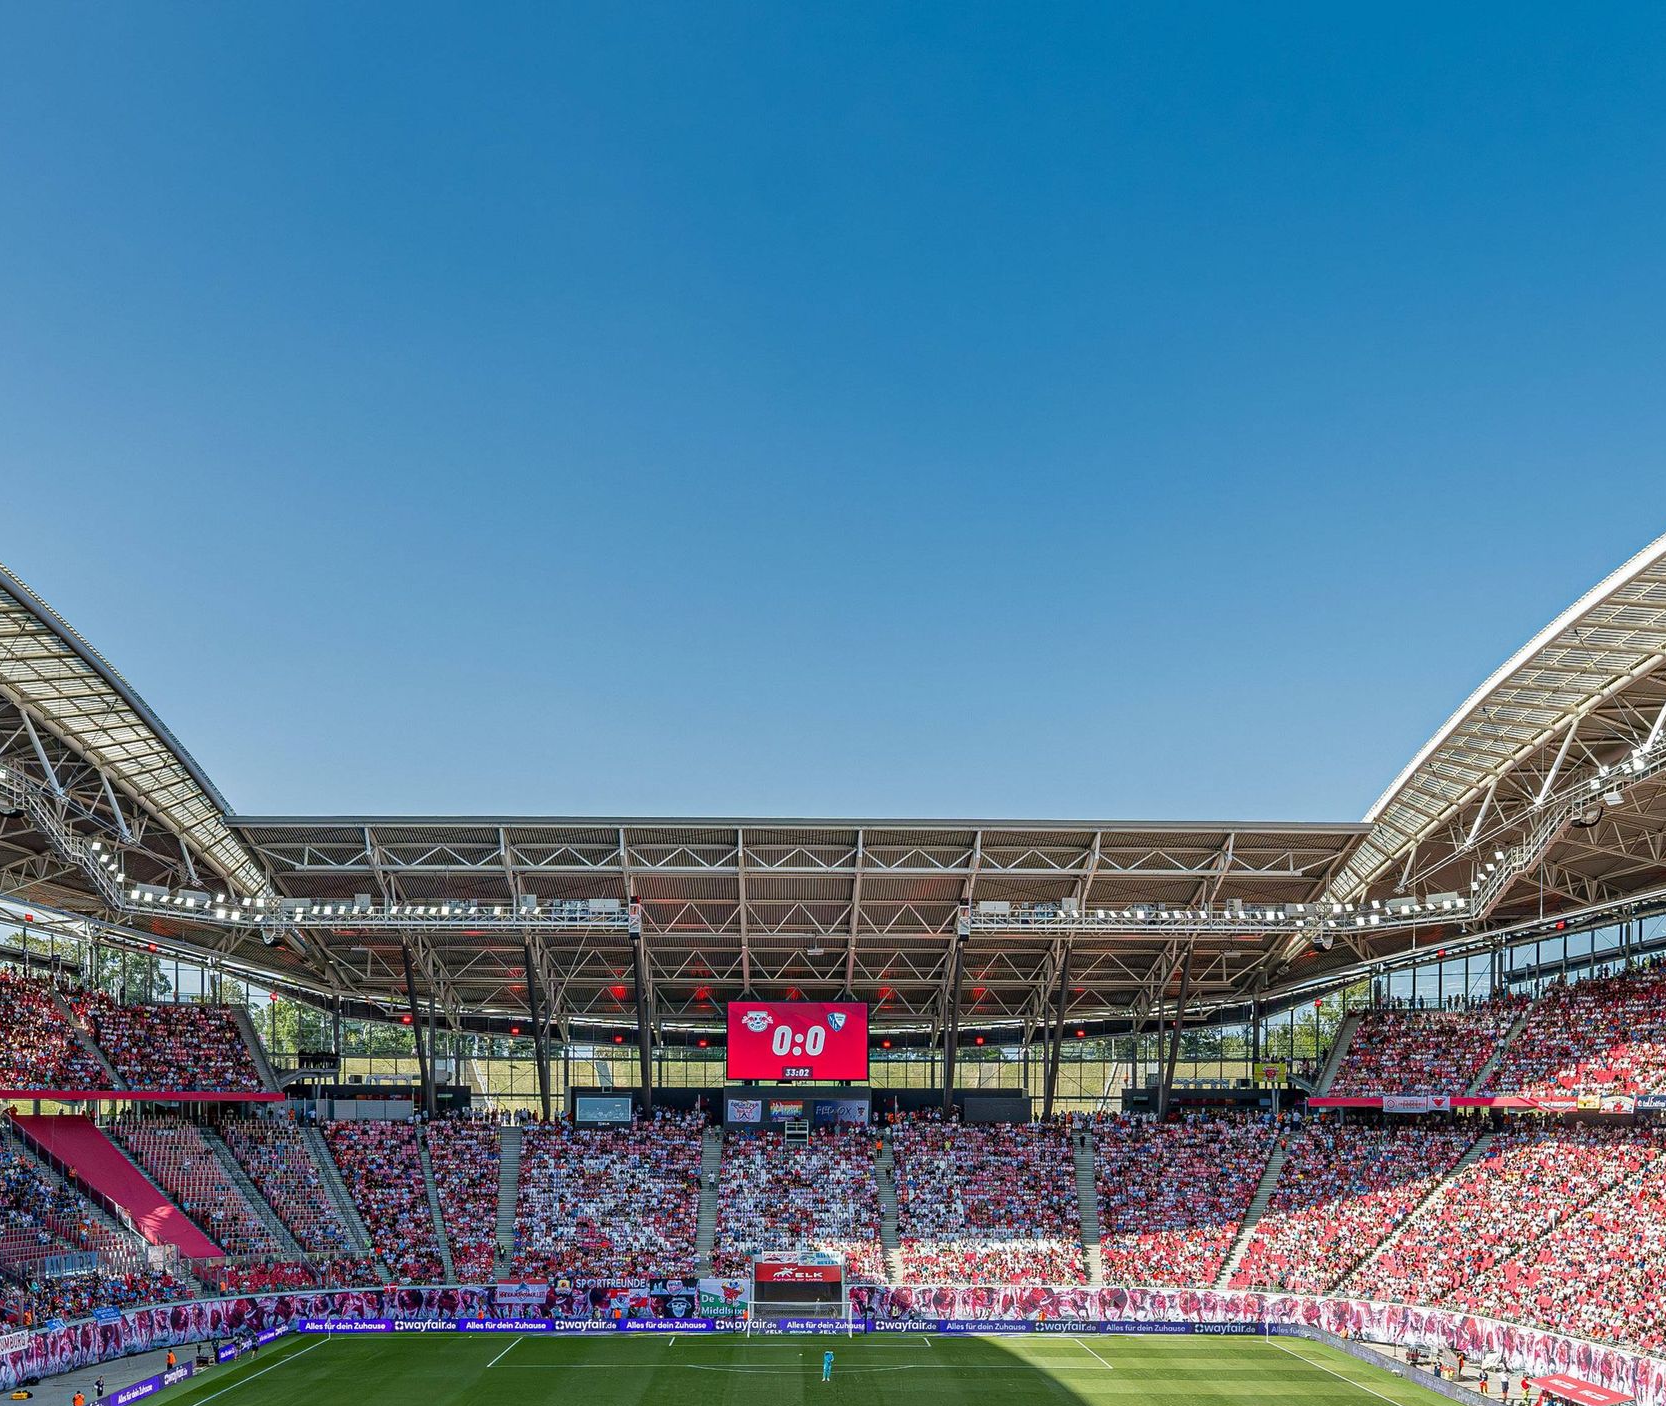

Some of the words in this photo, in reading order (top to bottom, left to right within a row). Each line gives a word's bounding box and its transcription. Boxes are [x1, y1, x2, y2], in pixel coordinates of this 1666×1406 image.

[772, 1025, 826, 1056] 0:0
[785, 1068, 810, 1077] 33:02
[575, 1278, 647, 1290] SPORTFREUNDE
[305, 1322, 324, 1330] Alles
[324, 1322, 336, 1331] für
[336, 1322, 353, 1331] dein
[354, 1322, 386, 1331] Zuhause
[403, 1319, 457, 1332] wayfair.de
[466, 1321, 484, 1330] Alles
[485, 1321, 496, 1330] für
[497, 1321, 513, 1330] dein
[514, 1321, 546, 1330] Zuhause
[564, 1318, 617, 1331] wayfair.de
[627, 1321, 645, 1330] Alles
[646, 1321, 656, 1330] für
[657, 1321, 673, 1330] dein
[674, 1321, 707, 1330] Zuhause
[725, 1319, 777, 1332] wayfair.de
[787, 1321, 805, 1330] Alles
[806, 1321, 817, 1330] für
[818, 1321, 834, 1330] dein
[835, 1321, 865, 1330] Zuhause
[885, 1320, 937, 1333] wayfair.de
[946, 1322, 964, 1331] Alles
[965, 1322, 976, 1331] für
[978, 1322, 994, 1331] dein
[995, 1322, 1026, 1331] Zuhause
[1045, 1321, 1096, 1333] wayfair.de
[1106, 1324, 1124, 1332] Alles
[1125, 1324, 1136, 1332] für
[1137, 1324, 1153, 1332] dein
[1154, 1324, 1185, 1332] Zuhause
[1204, 1323, 1256, 1335] wayfair.de
